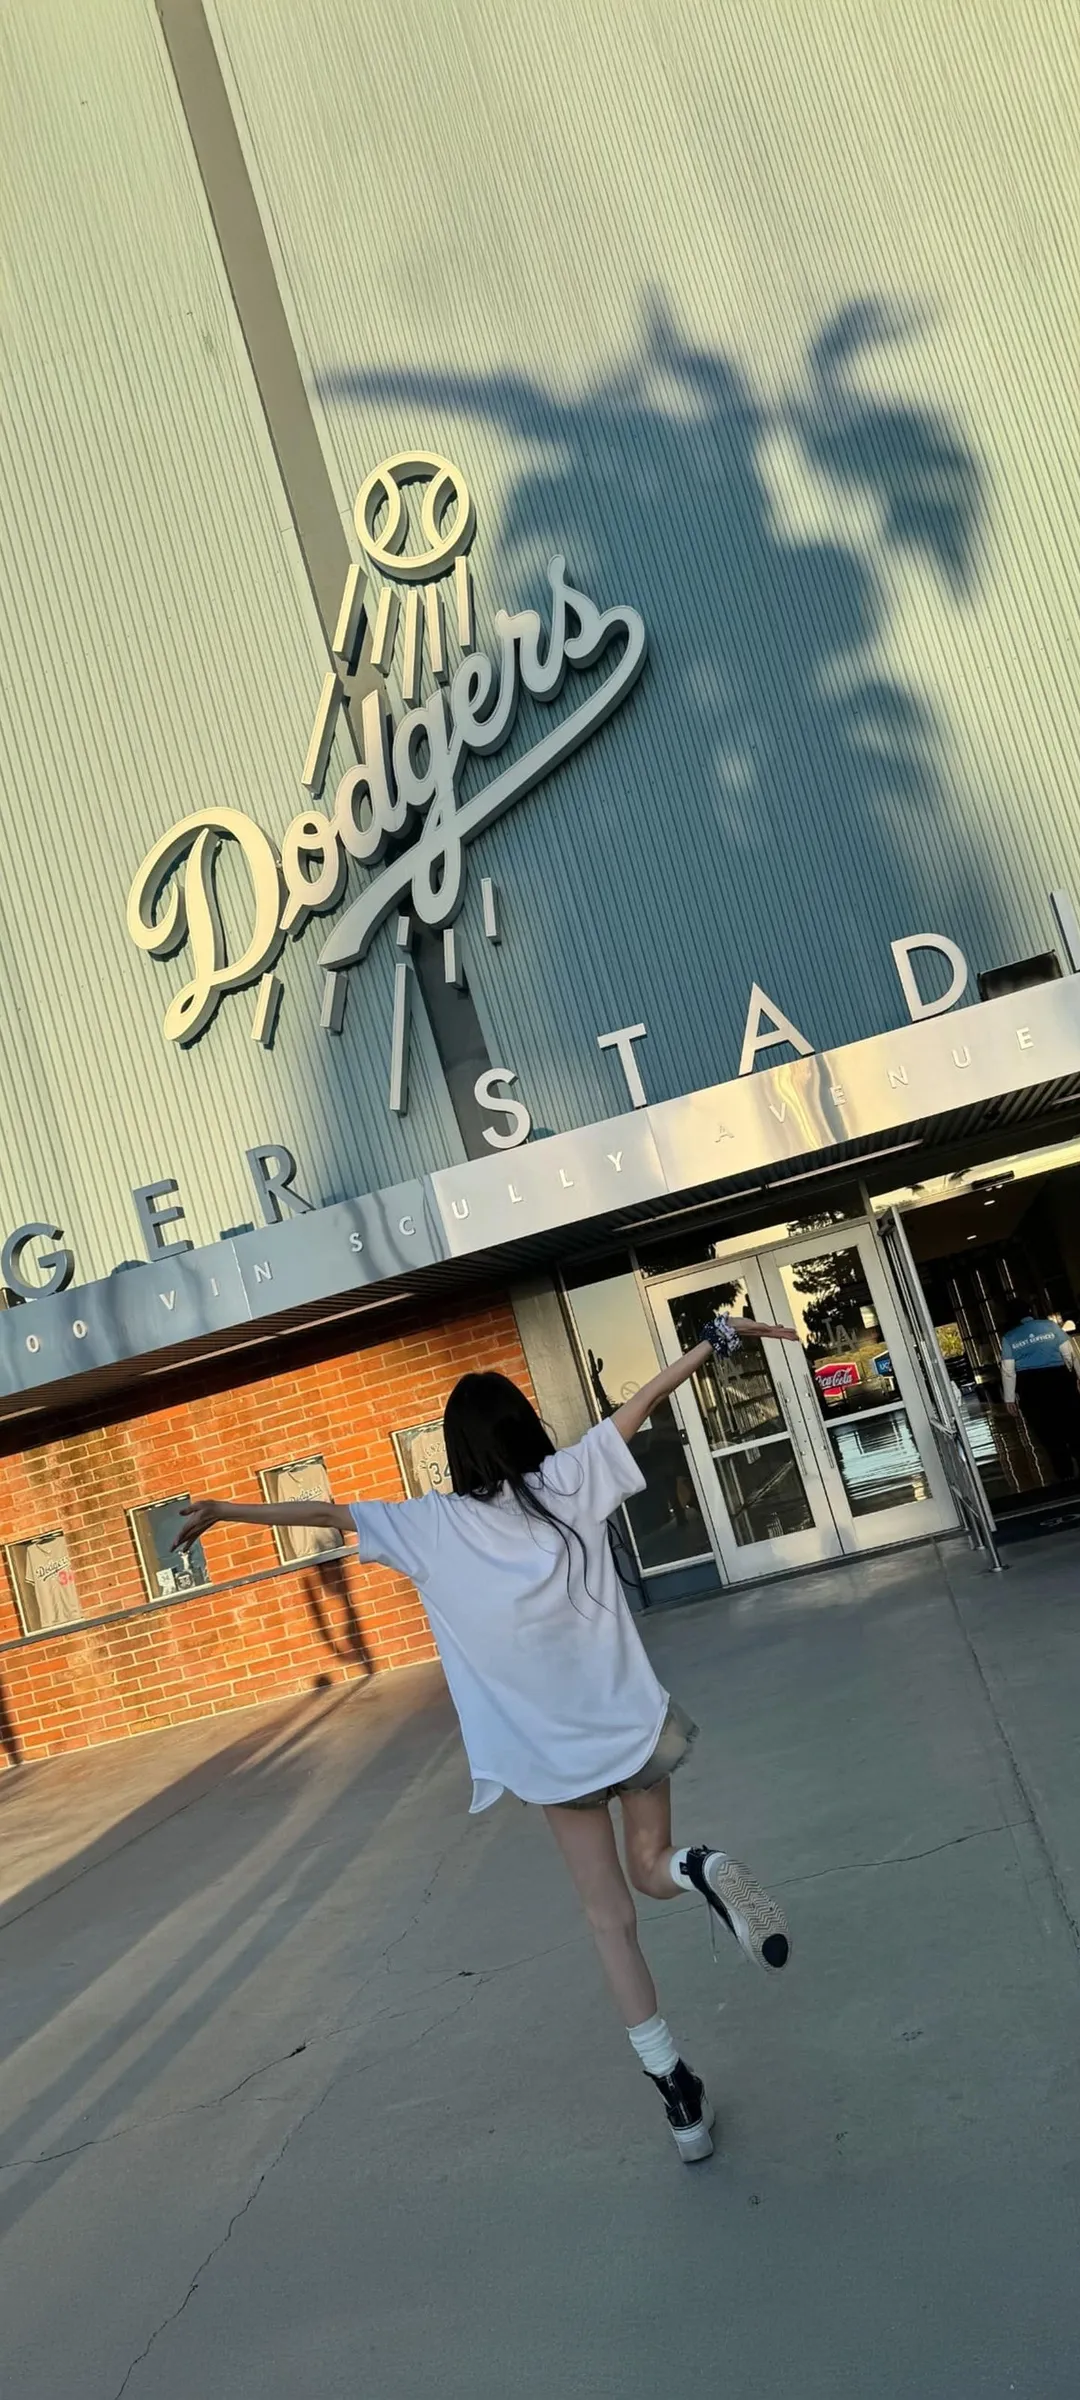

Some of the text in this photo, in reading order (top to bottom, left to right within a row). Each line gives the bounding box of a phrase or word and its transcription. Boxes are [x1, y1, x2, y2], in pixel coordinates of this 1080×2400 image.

[127, 555, 648, 1046] Dodgers
[1, 1144, 316, 1299] GER
[158, 1261, 274, 1311] VIN
[348, 1151, 625, 1254] SCULLY
[714, 1026, 1035, 1144] AVENUE
